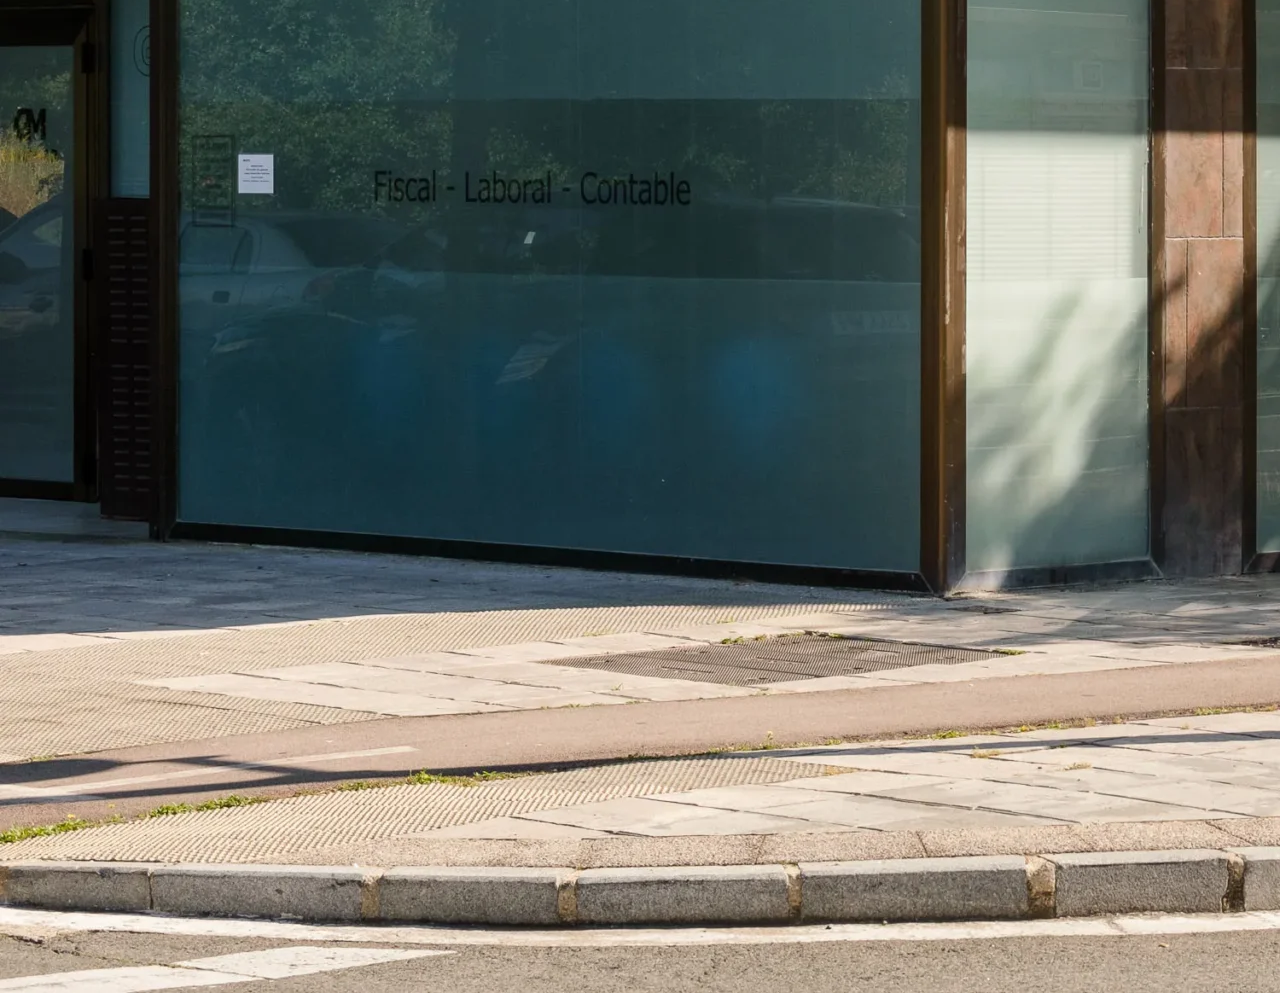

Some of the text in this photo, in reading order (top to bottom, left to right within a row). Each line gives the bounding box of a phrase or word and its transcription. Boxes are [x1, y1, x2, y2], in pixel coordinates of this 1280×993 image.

[373, 170, 436, 203] Fiscal
[465, 170, 552, 204] Laboral
[580, 172, 691, 205] Contable
